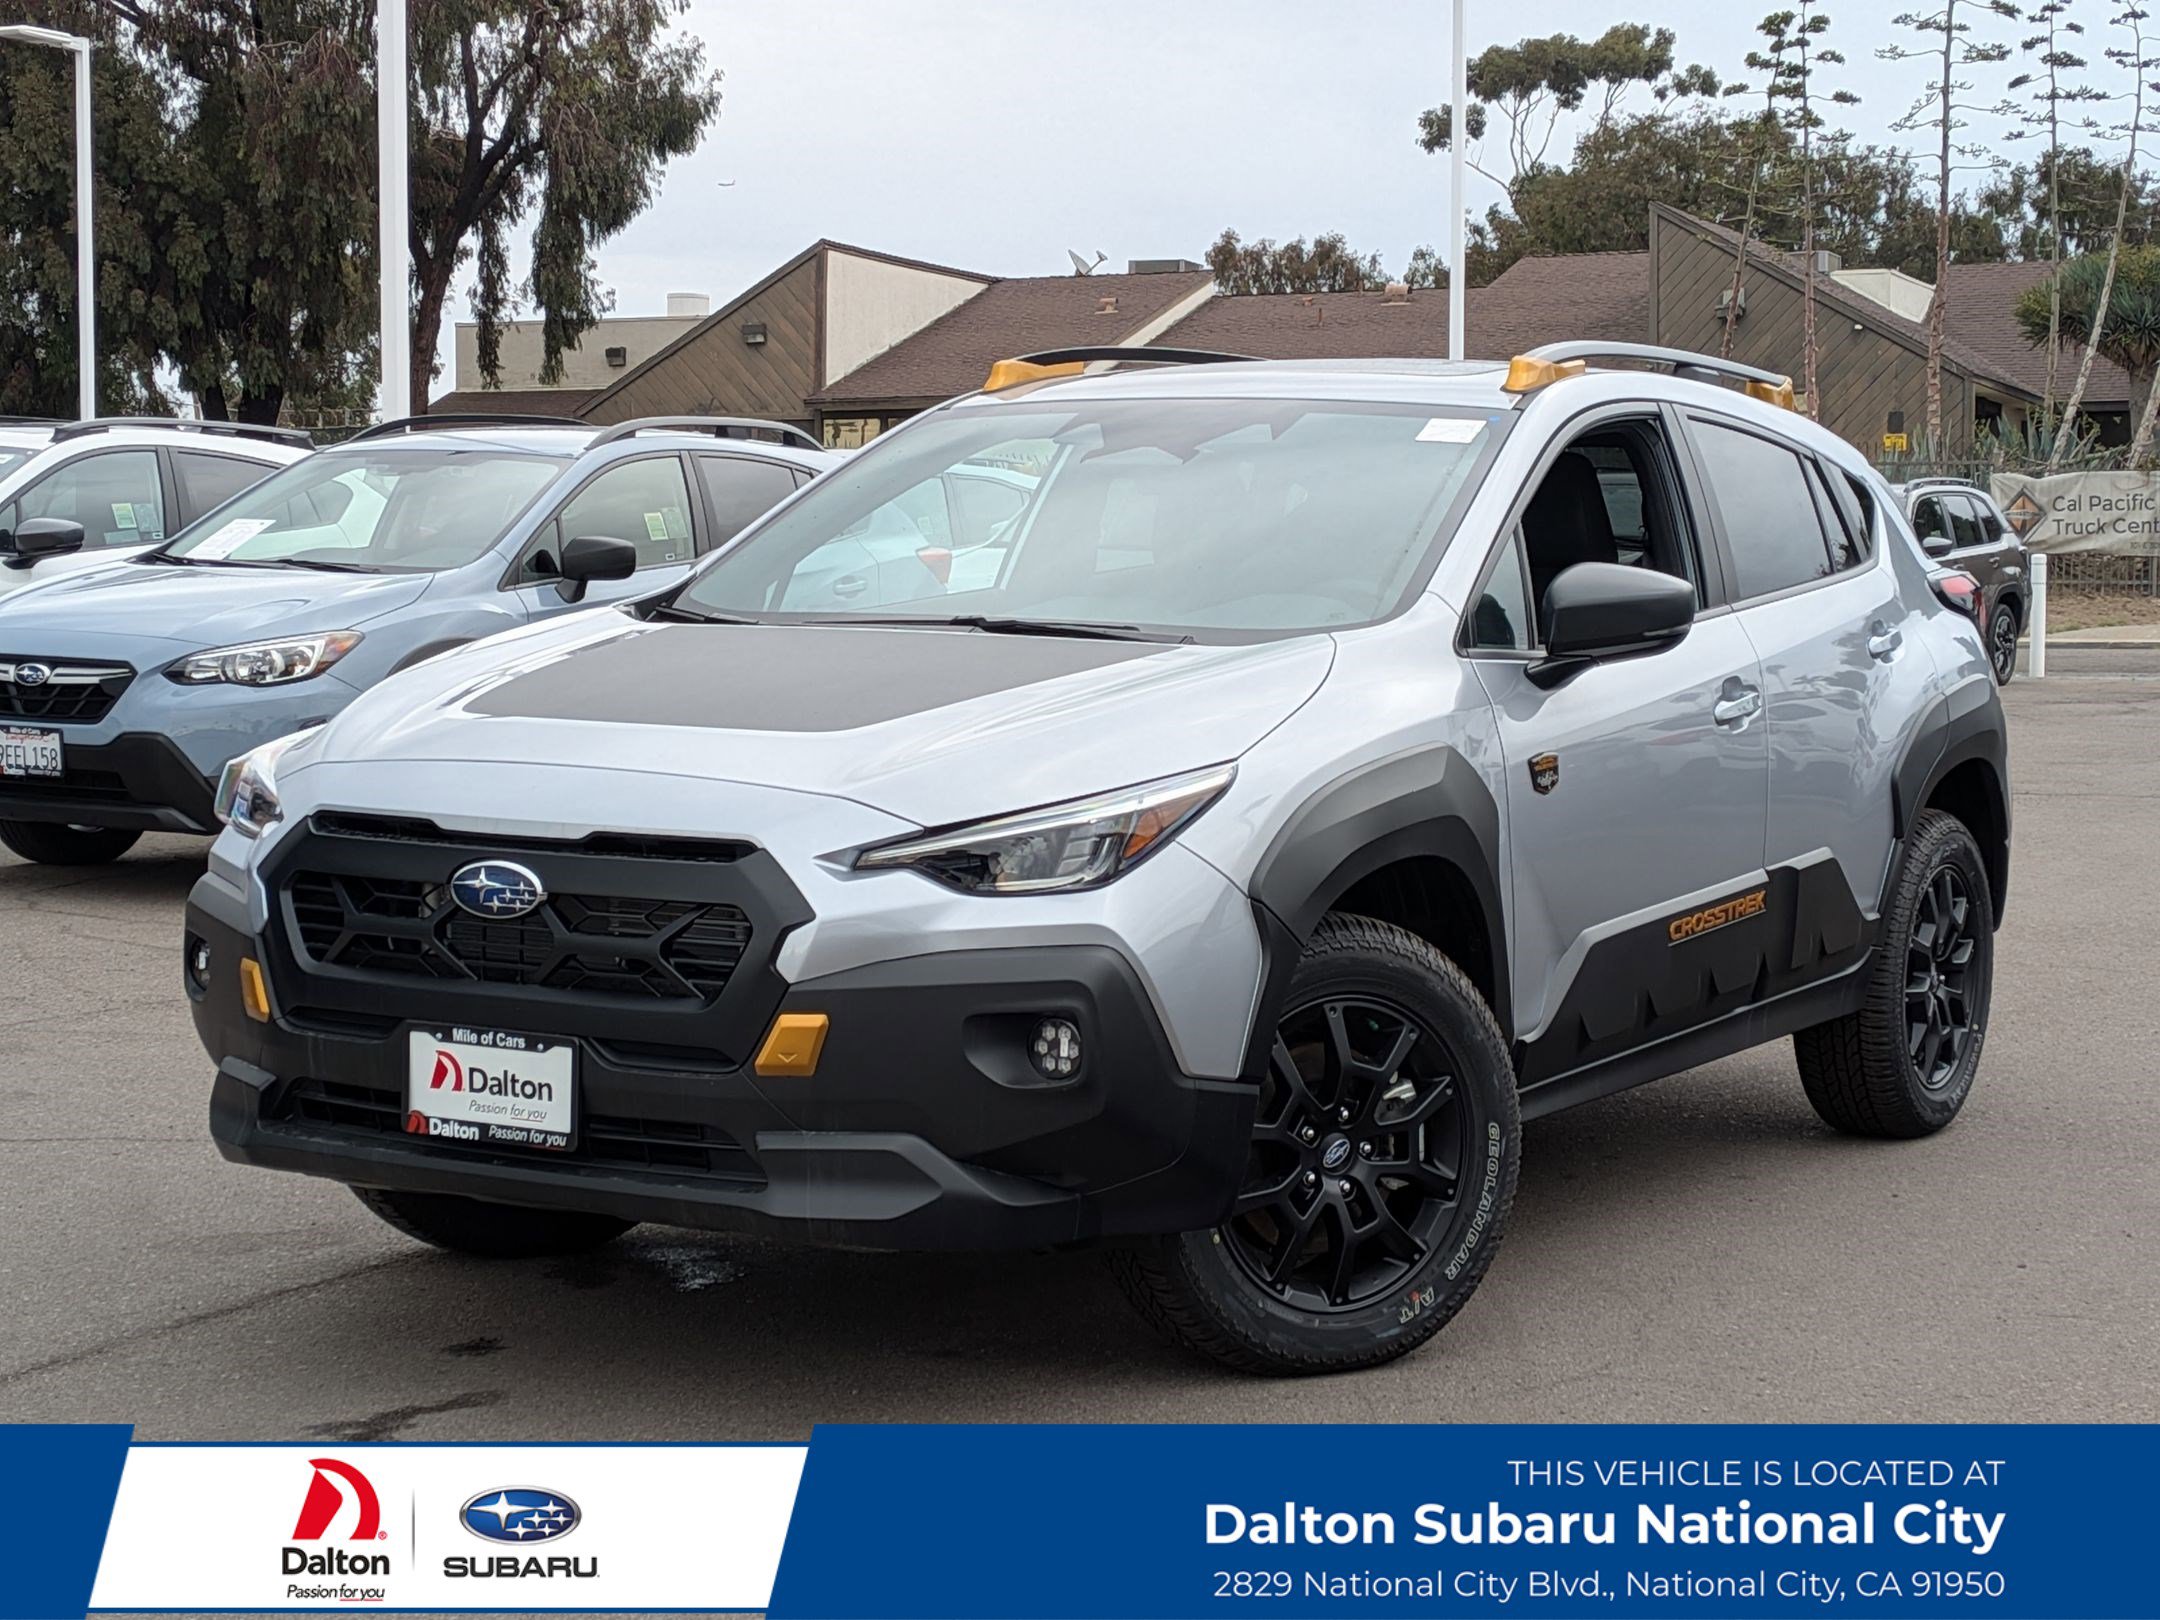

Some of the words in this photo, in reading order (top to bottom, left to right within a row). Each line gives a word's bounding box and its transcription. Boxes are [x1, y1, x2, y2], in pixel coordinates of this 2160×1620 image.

[2052, 495, 2082, 512] Cal
[2089, 493, 2156, 512] Pacific
[2053, 518, 2107, 535] Truck
[2112, 517, 2160, 534] Cent
[1670, 890, 1766, 941] CROSSTREK
[452, 1028, 477, 1043] Mile
[480, 1031, 495, 1046] of
[496, 1033, 526, 1049] Cars
[468, 1067, 553, 1102] Dalton
[468, 1100, 507, 1115] Passion
[510, 1104, 527, 1118] for
[526, 1109, 548, 1120] you
[429, 1118, 480, 1141] Dalton
[488, 1125, 527, 1143] Passion
[528, 1131, 546, 1144] for
[545, 1135, 567, 1148] you
[1444, 1122, 1500, 1281] GEOLANDAR
